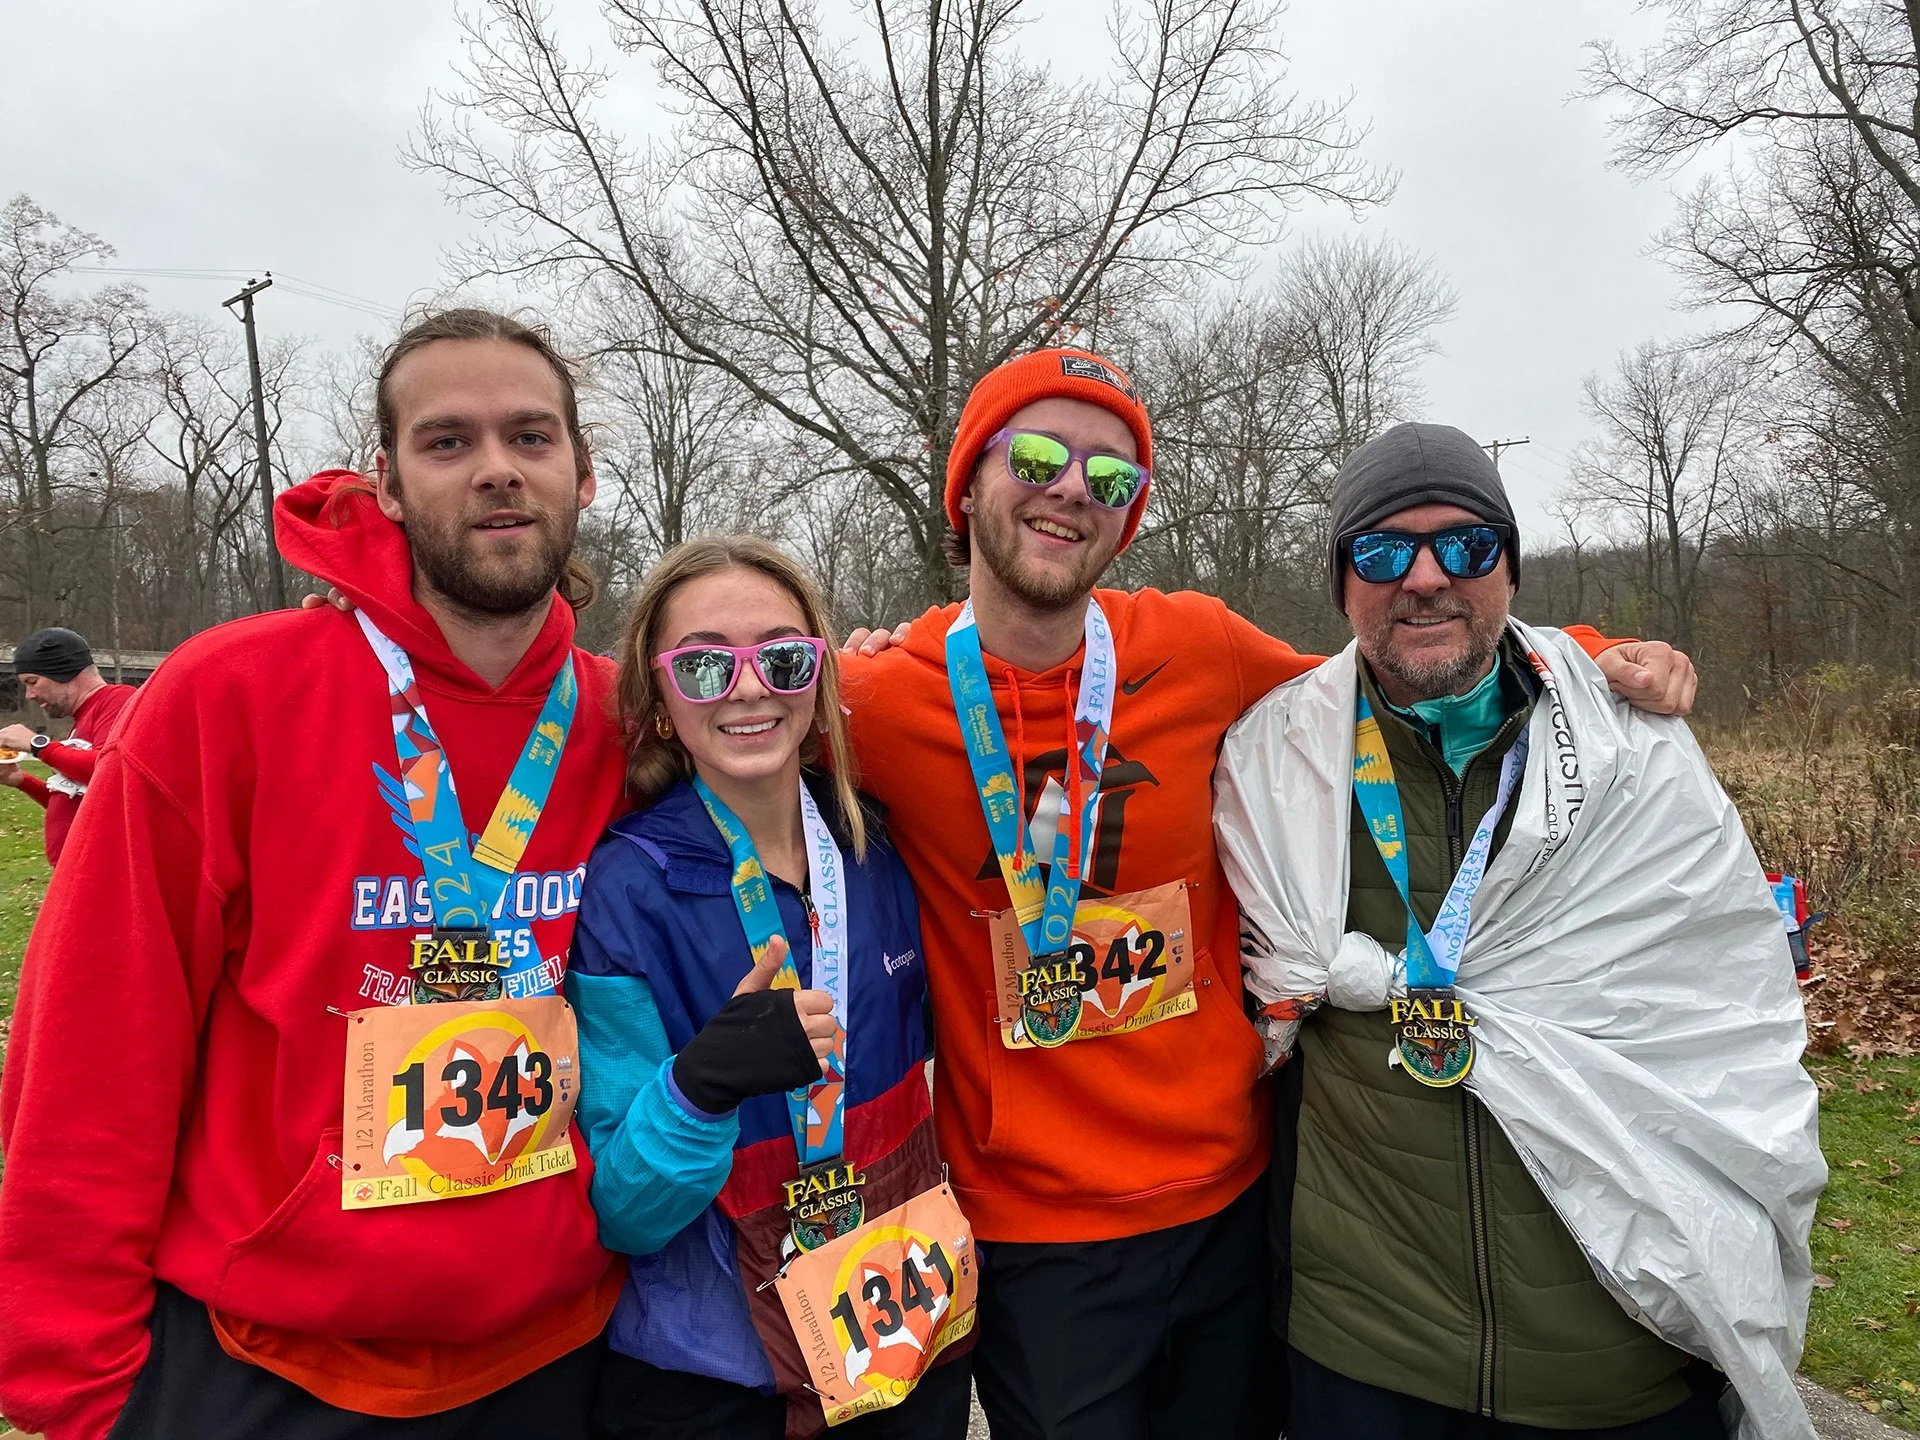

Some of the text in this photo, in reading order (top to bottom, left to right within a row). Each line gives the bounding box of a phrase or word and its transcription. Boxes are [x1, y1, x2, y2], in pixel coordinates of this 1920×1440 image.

[1088, 654, 1106, 710] FALL
[528, 736, 543, 760] LAND
[987, 799, 1001, 823] LAND
[1005, 797, 1016, 815] RUN
[1372, 818, 1382, 835] RUN
[1386, 814, 1398, 838] LAND
[1476, 828, 1491, 845] &
[354, 865, 587, 928] EASOOD
[425, 837, 479, 928] 024
[739, 887, 752, 913] LAND
[756, 882, 766, 903] RUN
[1436, 848, 1481, 939] RELAY
[816, 828, 839, 1005] ALL CLASSIC
[1446, 866, 1481, 962] MARATHON
[410, 938, 513, 970] FALL
[1002, 932, 1019, 991] Marathon
[1068, 930, 1167, 992] 342
[423, 970, 498, 985] CLASSIC
[501, 953, 570, 1000] FIEL
[1019, 958, 1086, 997] FALL
[1030, 985, 1078, 1006] CLASSIC
[1076, 997, 1191, 1037] lassic Drink Ticket
[1391, 998, 1478, 1027] FALL
[1403, 1026, 1466, 1040] CLASSIC
[356, 1041, 374, 1151] 1/2 Marathon
[392, 1051, 554, 1131] 1343
[376, 1150, 571, 1200] Fall Classic Drink Ticket
[782, 1161, 866, 1211] FALL
[799, 1190, 857, 1219] CLASSIC
[830, 1241, 954, 1353] 1341
[796, 1288, 839, 1386] 1/2 Marathon
[852, 1389, 887, 1414] Fall
